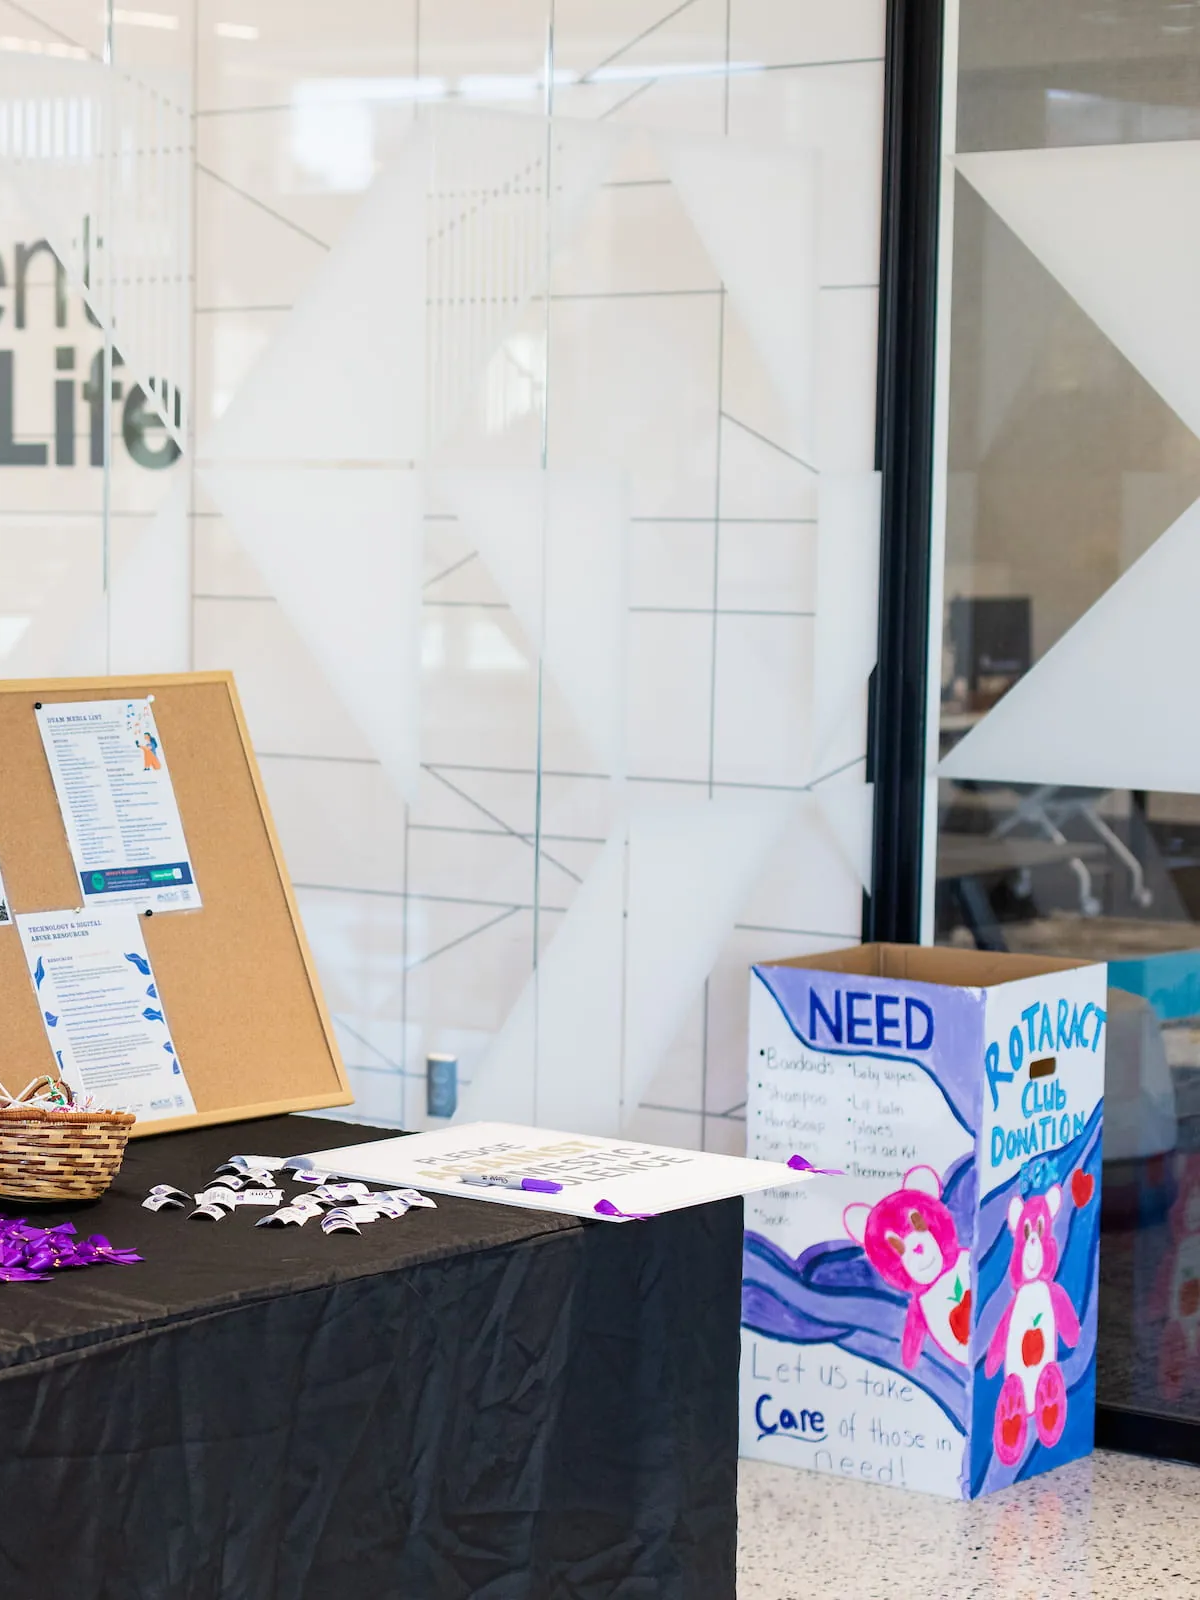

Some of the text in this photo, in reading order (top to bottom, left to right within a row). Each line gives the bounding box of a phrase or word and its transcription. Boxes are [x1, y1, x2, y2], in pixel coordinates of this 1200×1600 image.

[28, 923, 70, 933] TECHNOLOGY
[76, 919, 103, 929] DIGITAL
[31, 930, 89, 942] ABUSE RESOURCES
[808, 986, 935, 1050] NEED
[767, 1047, 835, 1075] Bandaids
[984, 998, 1108, 1112] ROTARACT
[415, 1142, 526, 1166] PLEDGE
[991, 1110, 1085, 1168] DONATION
[417, 1140, 602, 1181] AGAINST
[505, 1148, 652, 1178] MESTIC
[546, 1155, 694, 1186] OLENCE
[1019, 1158, 1060, 1194] BOX
[751, 1342, 915, 1403] Let us take
[755, 1393, 952, 1452] Care of those in
[814, 1450, 907, 1487] need!
